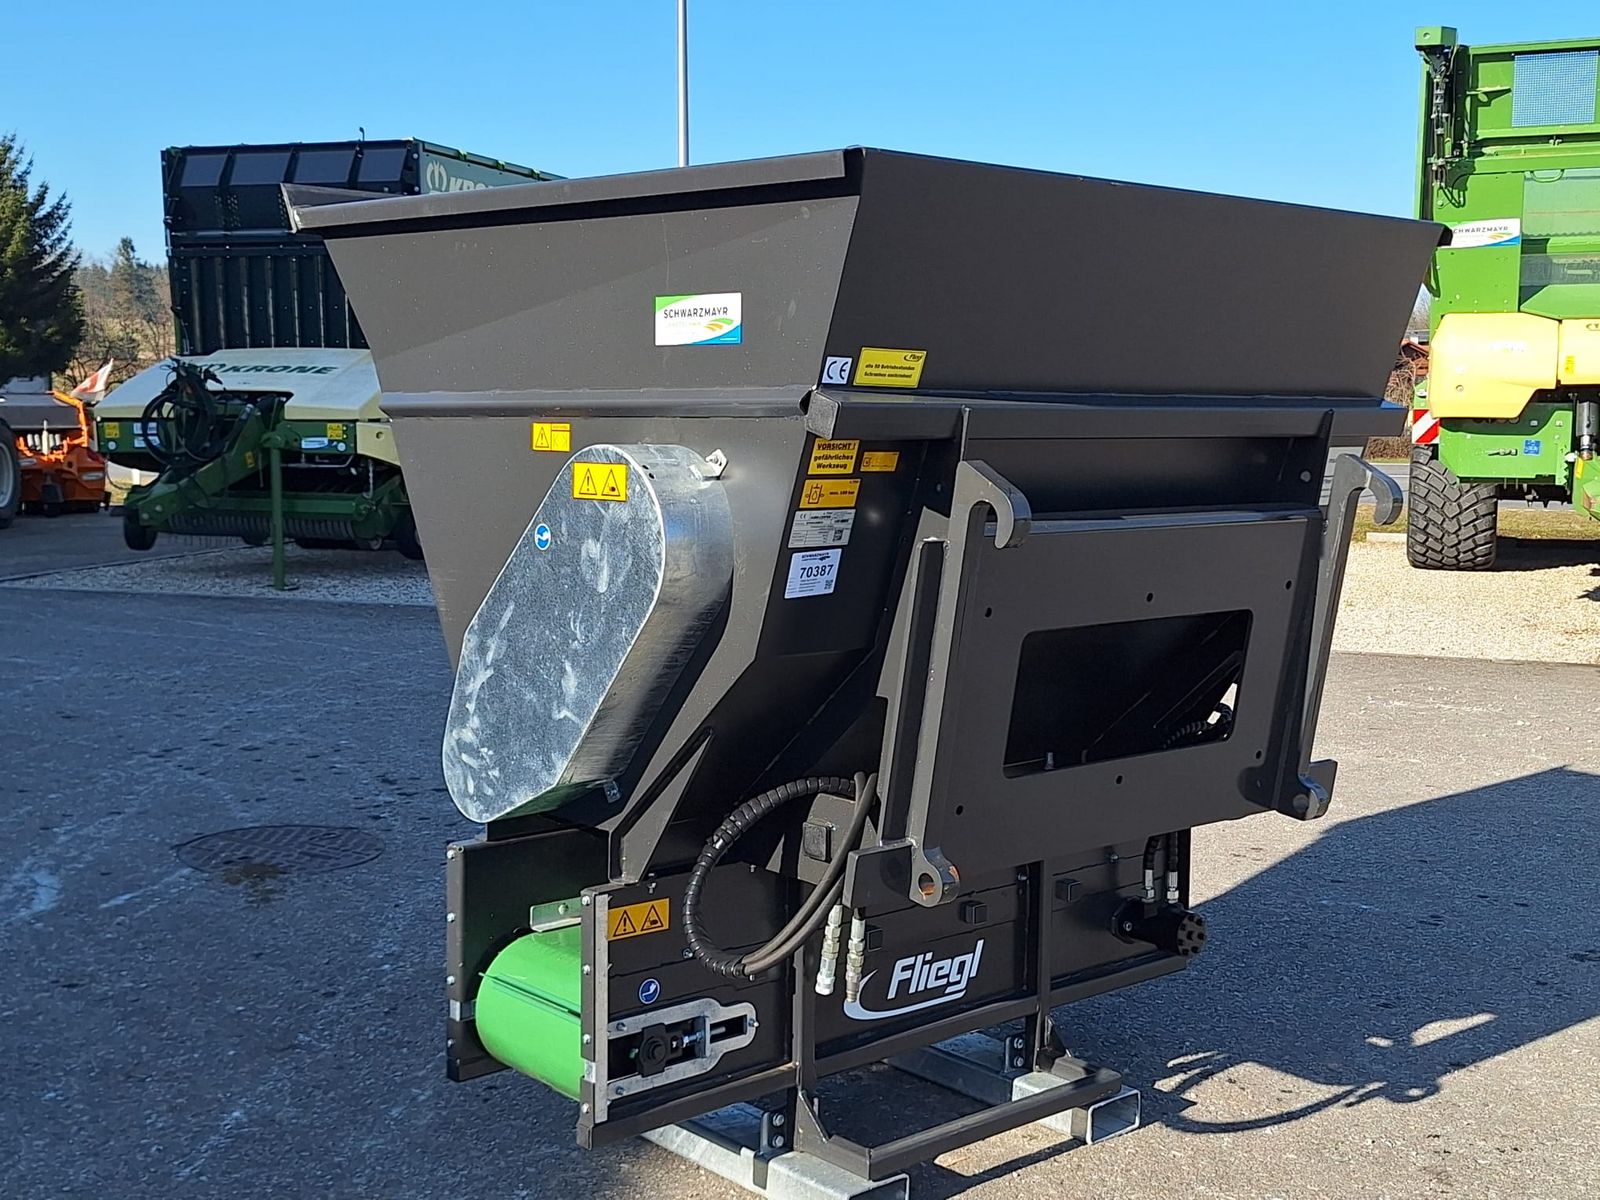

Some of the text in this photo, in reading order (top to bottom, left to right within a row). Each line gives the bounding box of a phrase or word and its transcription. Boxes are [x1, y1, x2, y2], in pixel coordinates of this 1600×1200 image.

[1453, 225, 1509, 235] CHWARZMAYR
[663, 306, 729, 319] SCHWARZMAYR
[221, 365, 338, 375] KRONE
[826, 360, 849, 380] CE
[817, 443, 852, 451] VORSICHT
[813, 453, 853, 462] gefährliches
[800, 564, 834, 579] 70387
[887, 939, 985, 1000] Fliegl
